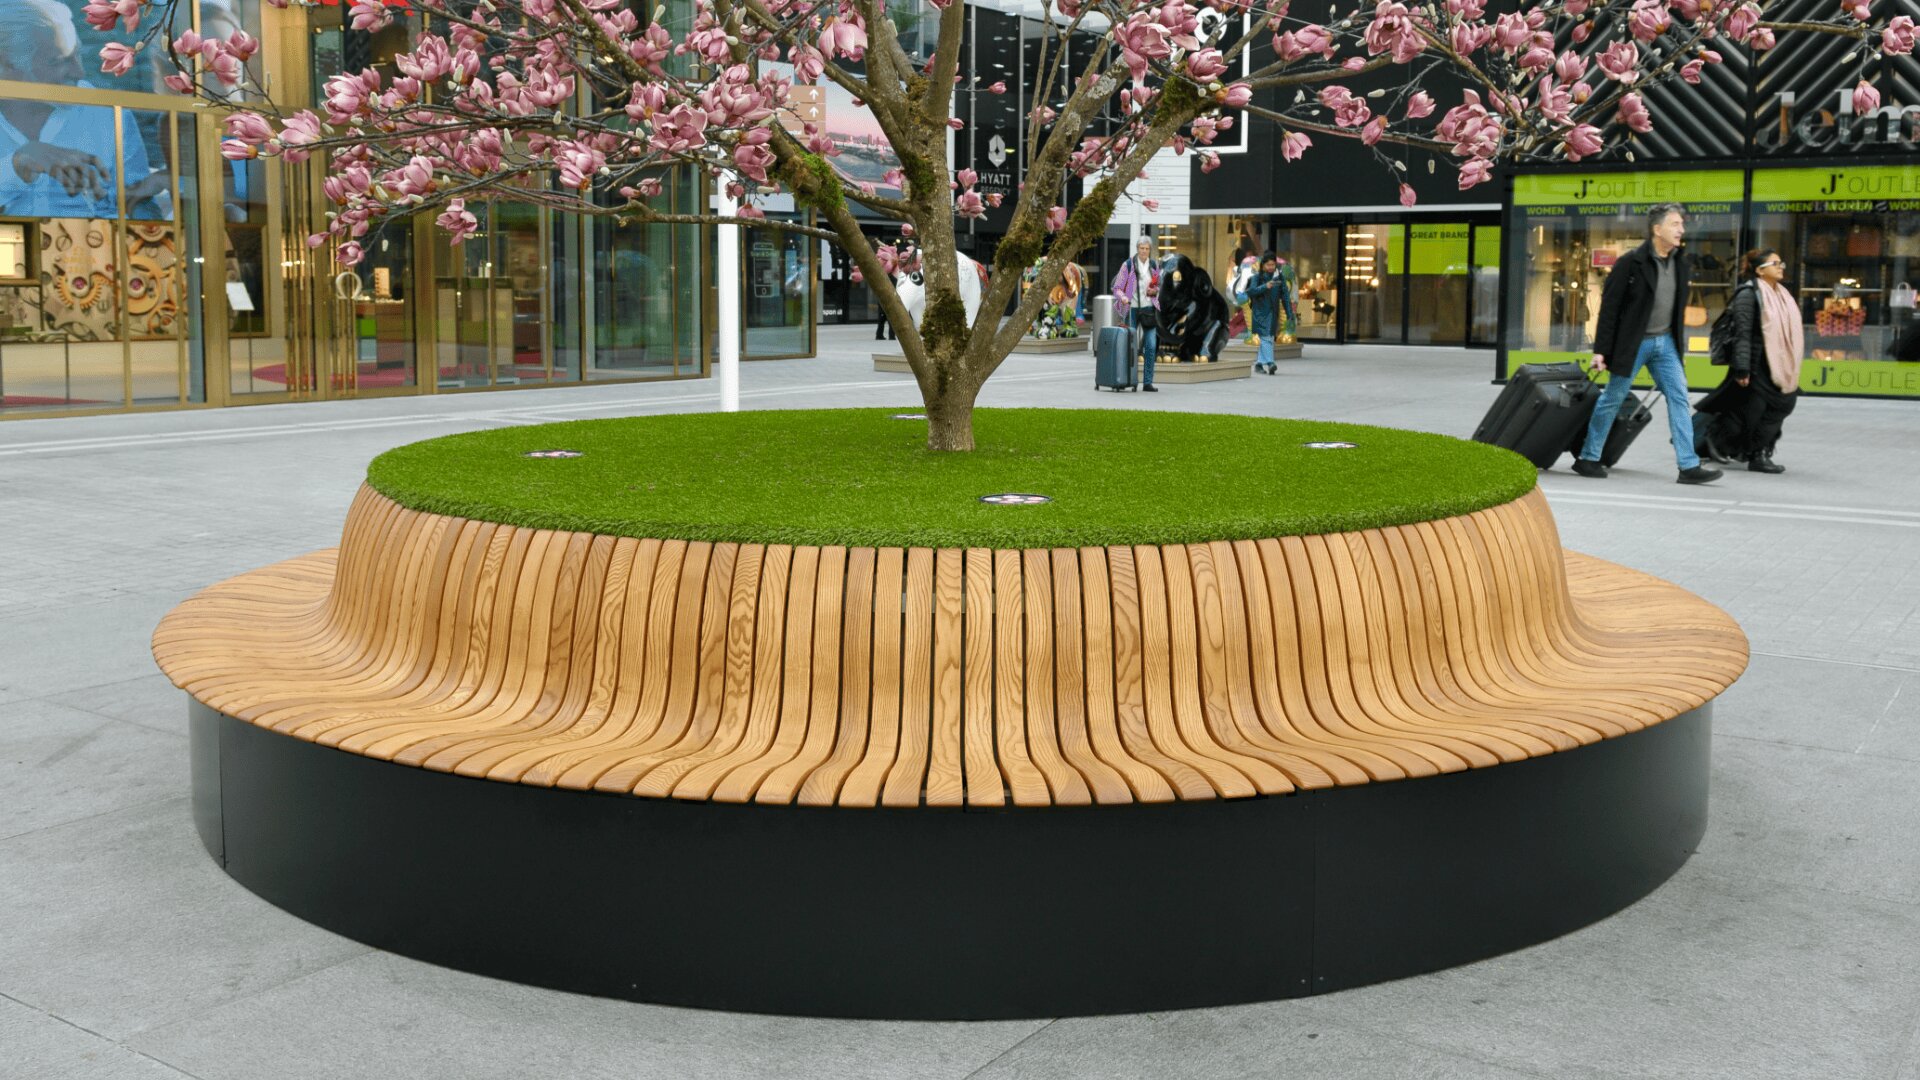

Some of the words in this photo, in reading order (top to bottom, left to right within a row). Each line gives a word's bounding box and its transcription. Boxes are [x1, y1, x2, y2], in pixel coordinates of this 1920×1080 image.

[980, 172, 1012, 186] HYATT
[1597, 180, 1682, 199] OUTLET
[1526, 206, 1565, 215] WOMEN
[1578, 205, 1618, 215] WOMEN
[1689, 204, 1731, 213] WOMEN
[1767, 202, 1814, 212] WOMEN
[1410, 231, 1438, 239] GREAT
